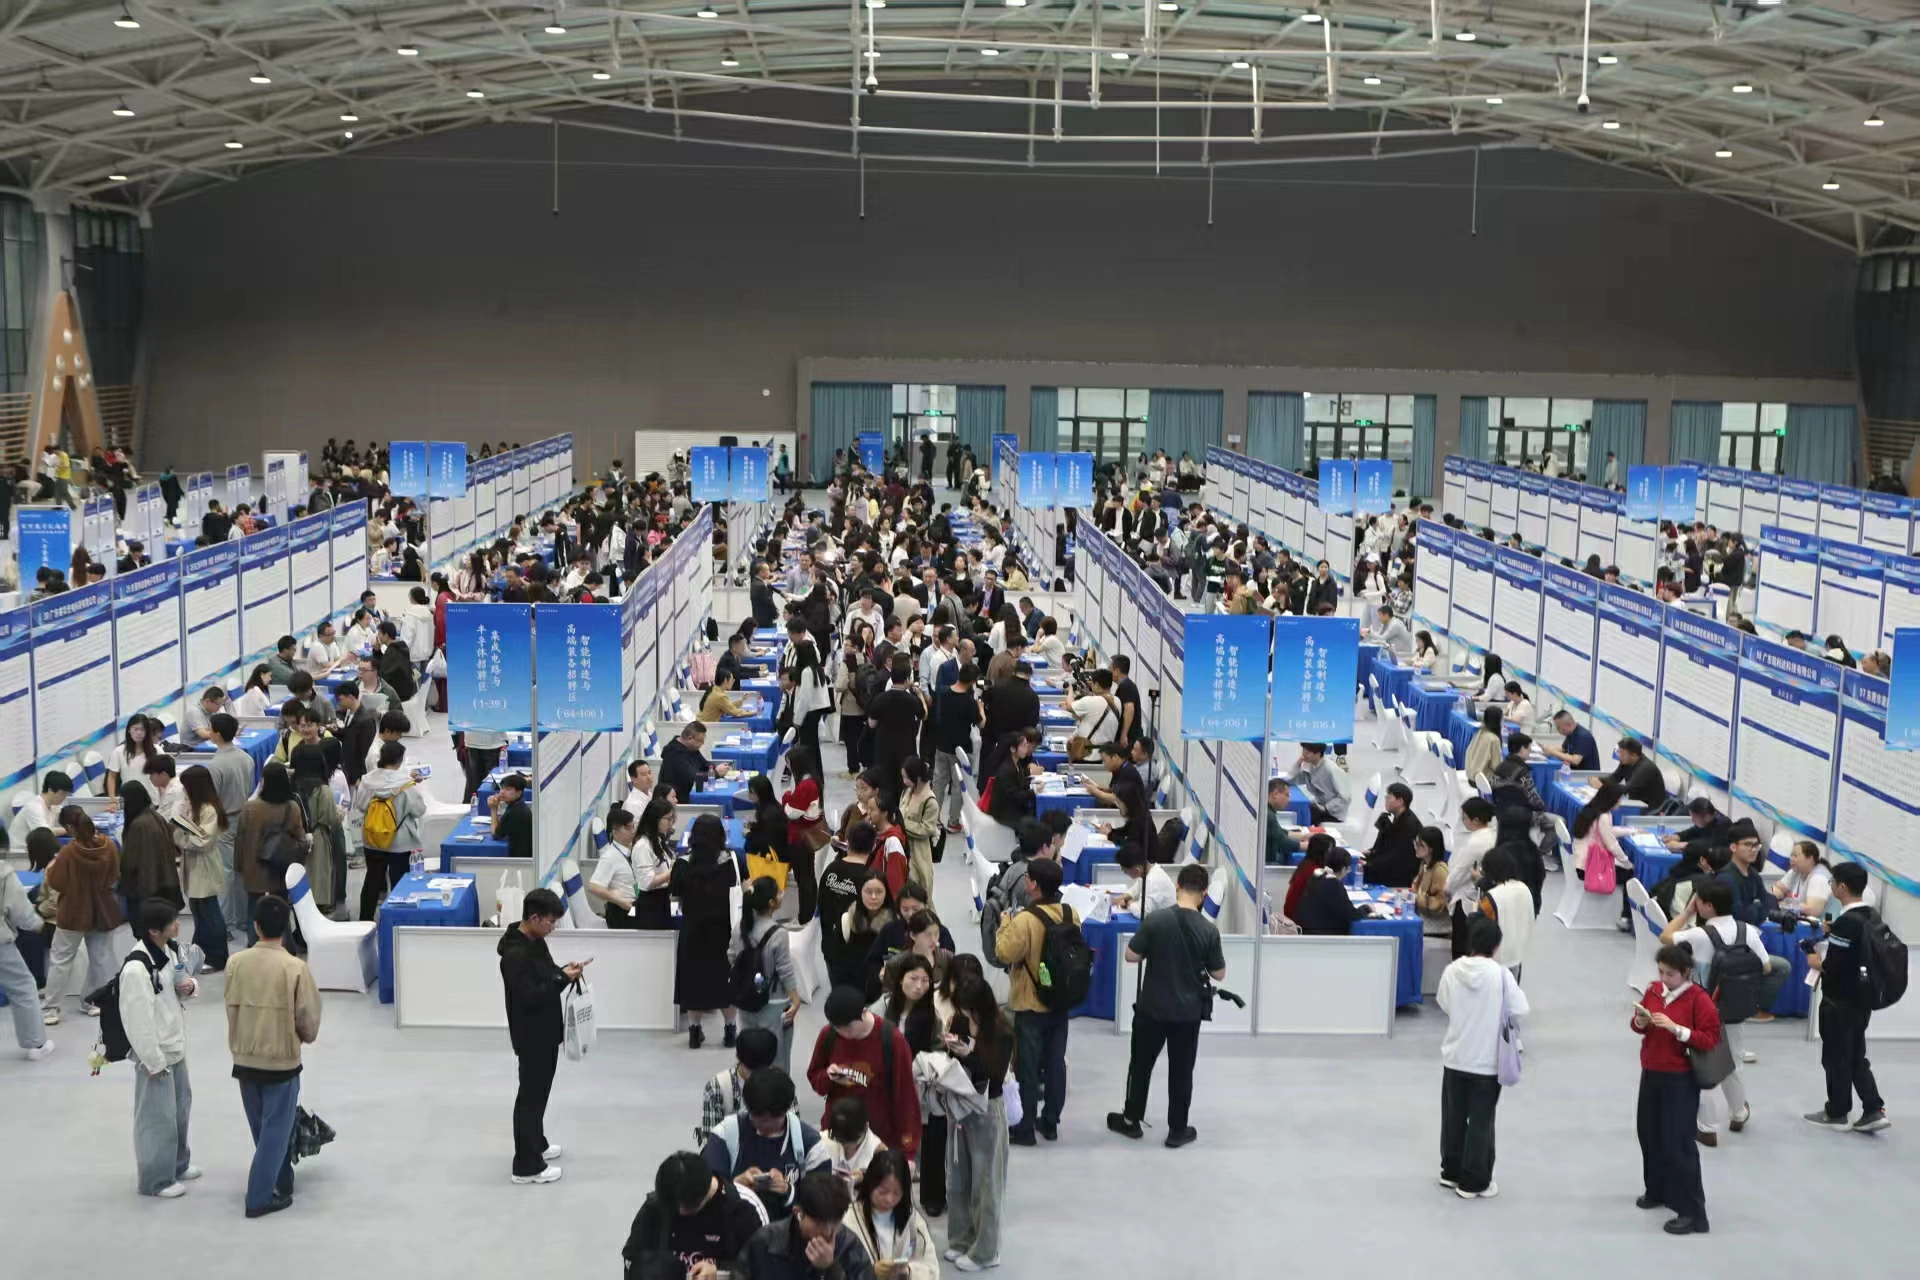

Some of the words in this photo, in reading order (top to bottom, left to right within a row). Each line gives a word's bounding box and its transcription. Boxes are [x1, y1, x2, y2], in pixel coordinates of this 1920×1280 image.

[476, 624, 488, 692] 半导体招聘区
[490, 630, 501, 687] 集成电路与
[566, 624, 577, 702] 高端装备招聘区
[580, 635, 592, 692] 智能制造与
